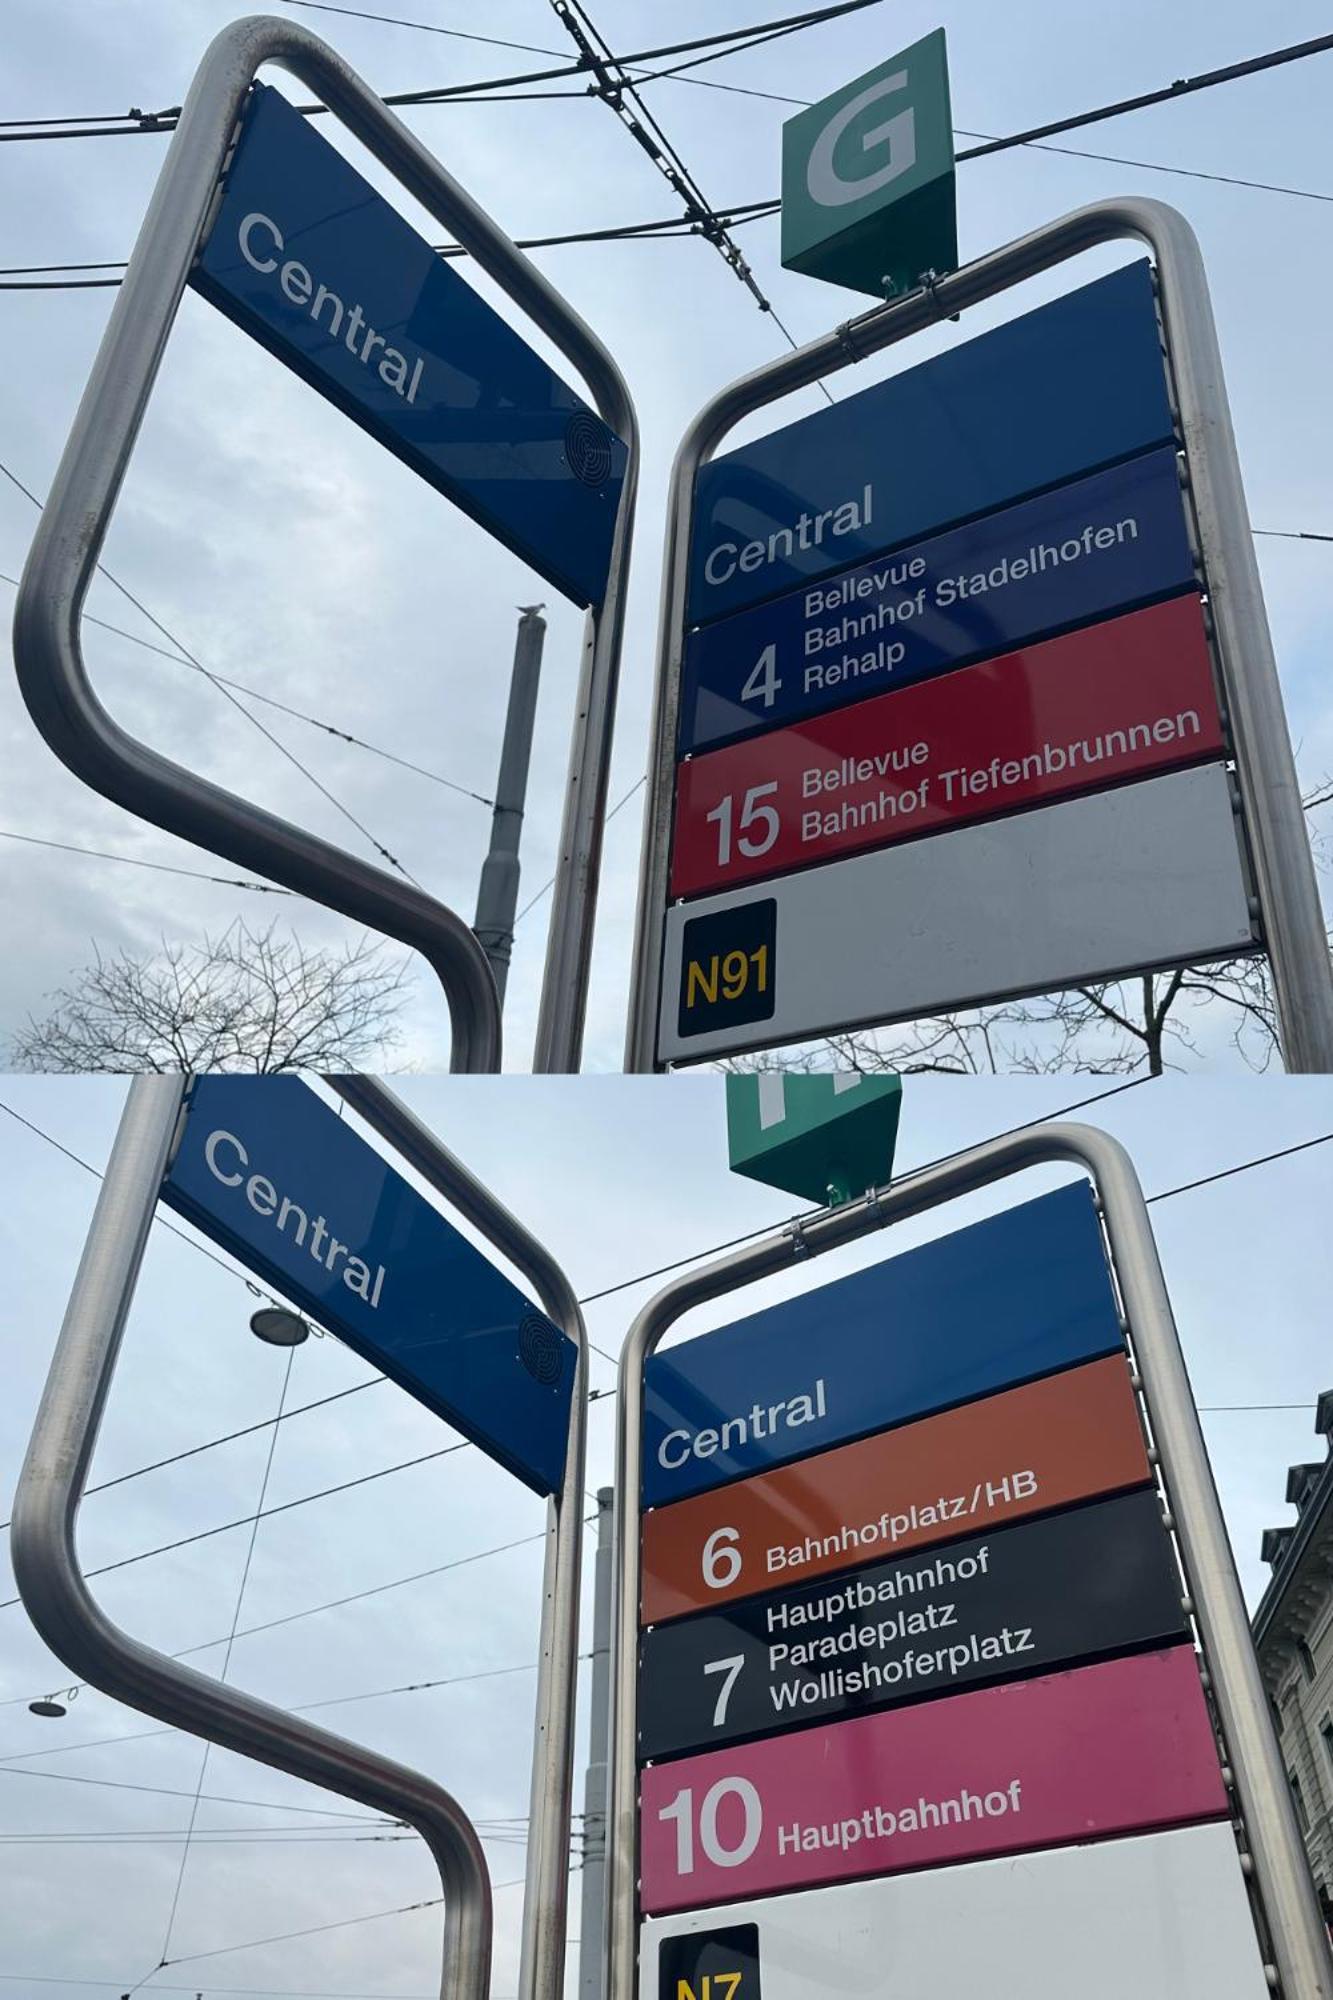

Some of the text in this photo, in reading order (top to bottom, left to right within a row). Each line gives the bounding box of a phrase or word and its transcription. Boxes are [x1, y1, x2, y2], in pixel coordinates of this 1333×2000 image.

[805, 67, 917, 208] G
[238, 212, 425, 404] Central
[704, 483, 873, 585] Central
[804, 518, 1138, 656] Bahnhof Stadelhofen
[805, 557, 926, 619] Bellevue
[741, 643, 782, 708] 4
[804, 641, 905, 694] Rehalp
[801, 710, 1201, 842] Bahnhof Tiefenbrunnen
[802, 742, 929, 799] Bellevue
[706, 780, 780, 866] 15
[686, 944, 767, 1009] N91
[205, 1129, 386, 1308] Central
[658, 1378, 826, 1469] Central
[701, 1470, 1038, 1589] 6 Bahnhofplatz/HB
[767, 1546, 989, 1633] Hauptbahnhof
[769, 1603, 958, 1672] Paradeplatz
[769, 1628, 1036, 1711] Wollishoferplatz
[703, 1653, 745, 1727] 7
[658, 1776, 1022, 1875] 10 Hauptbahnhof
